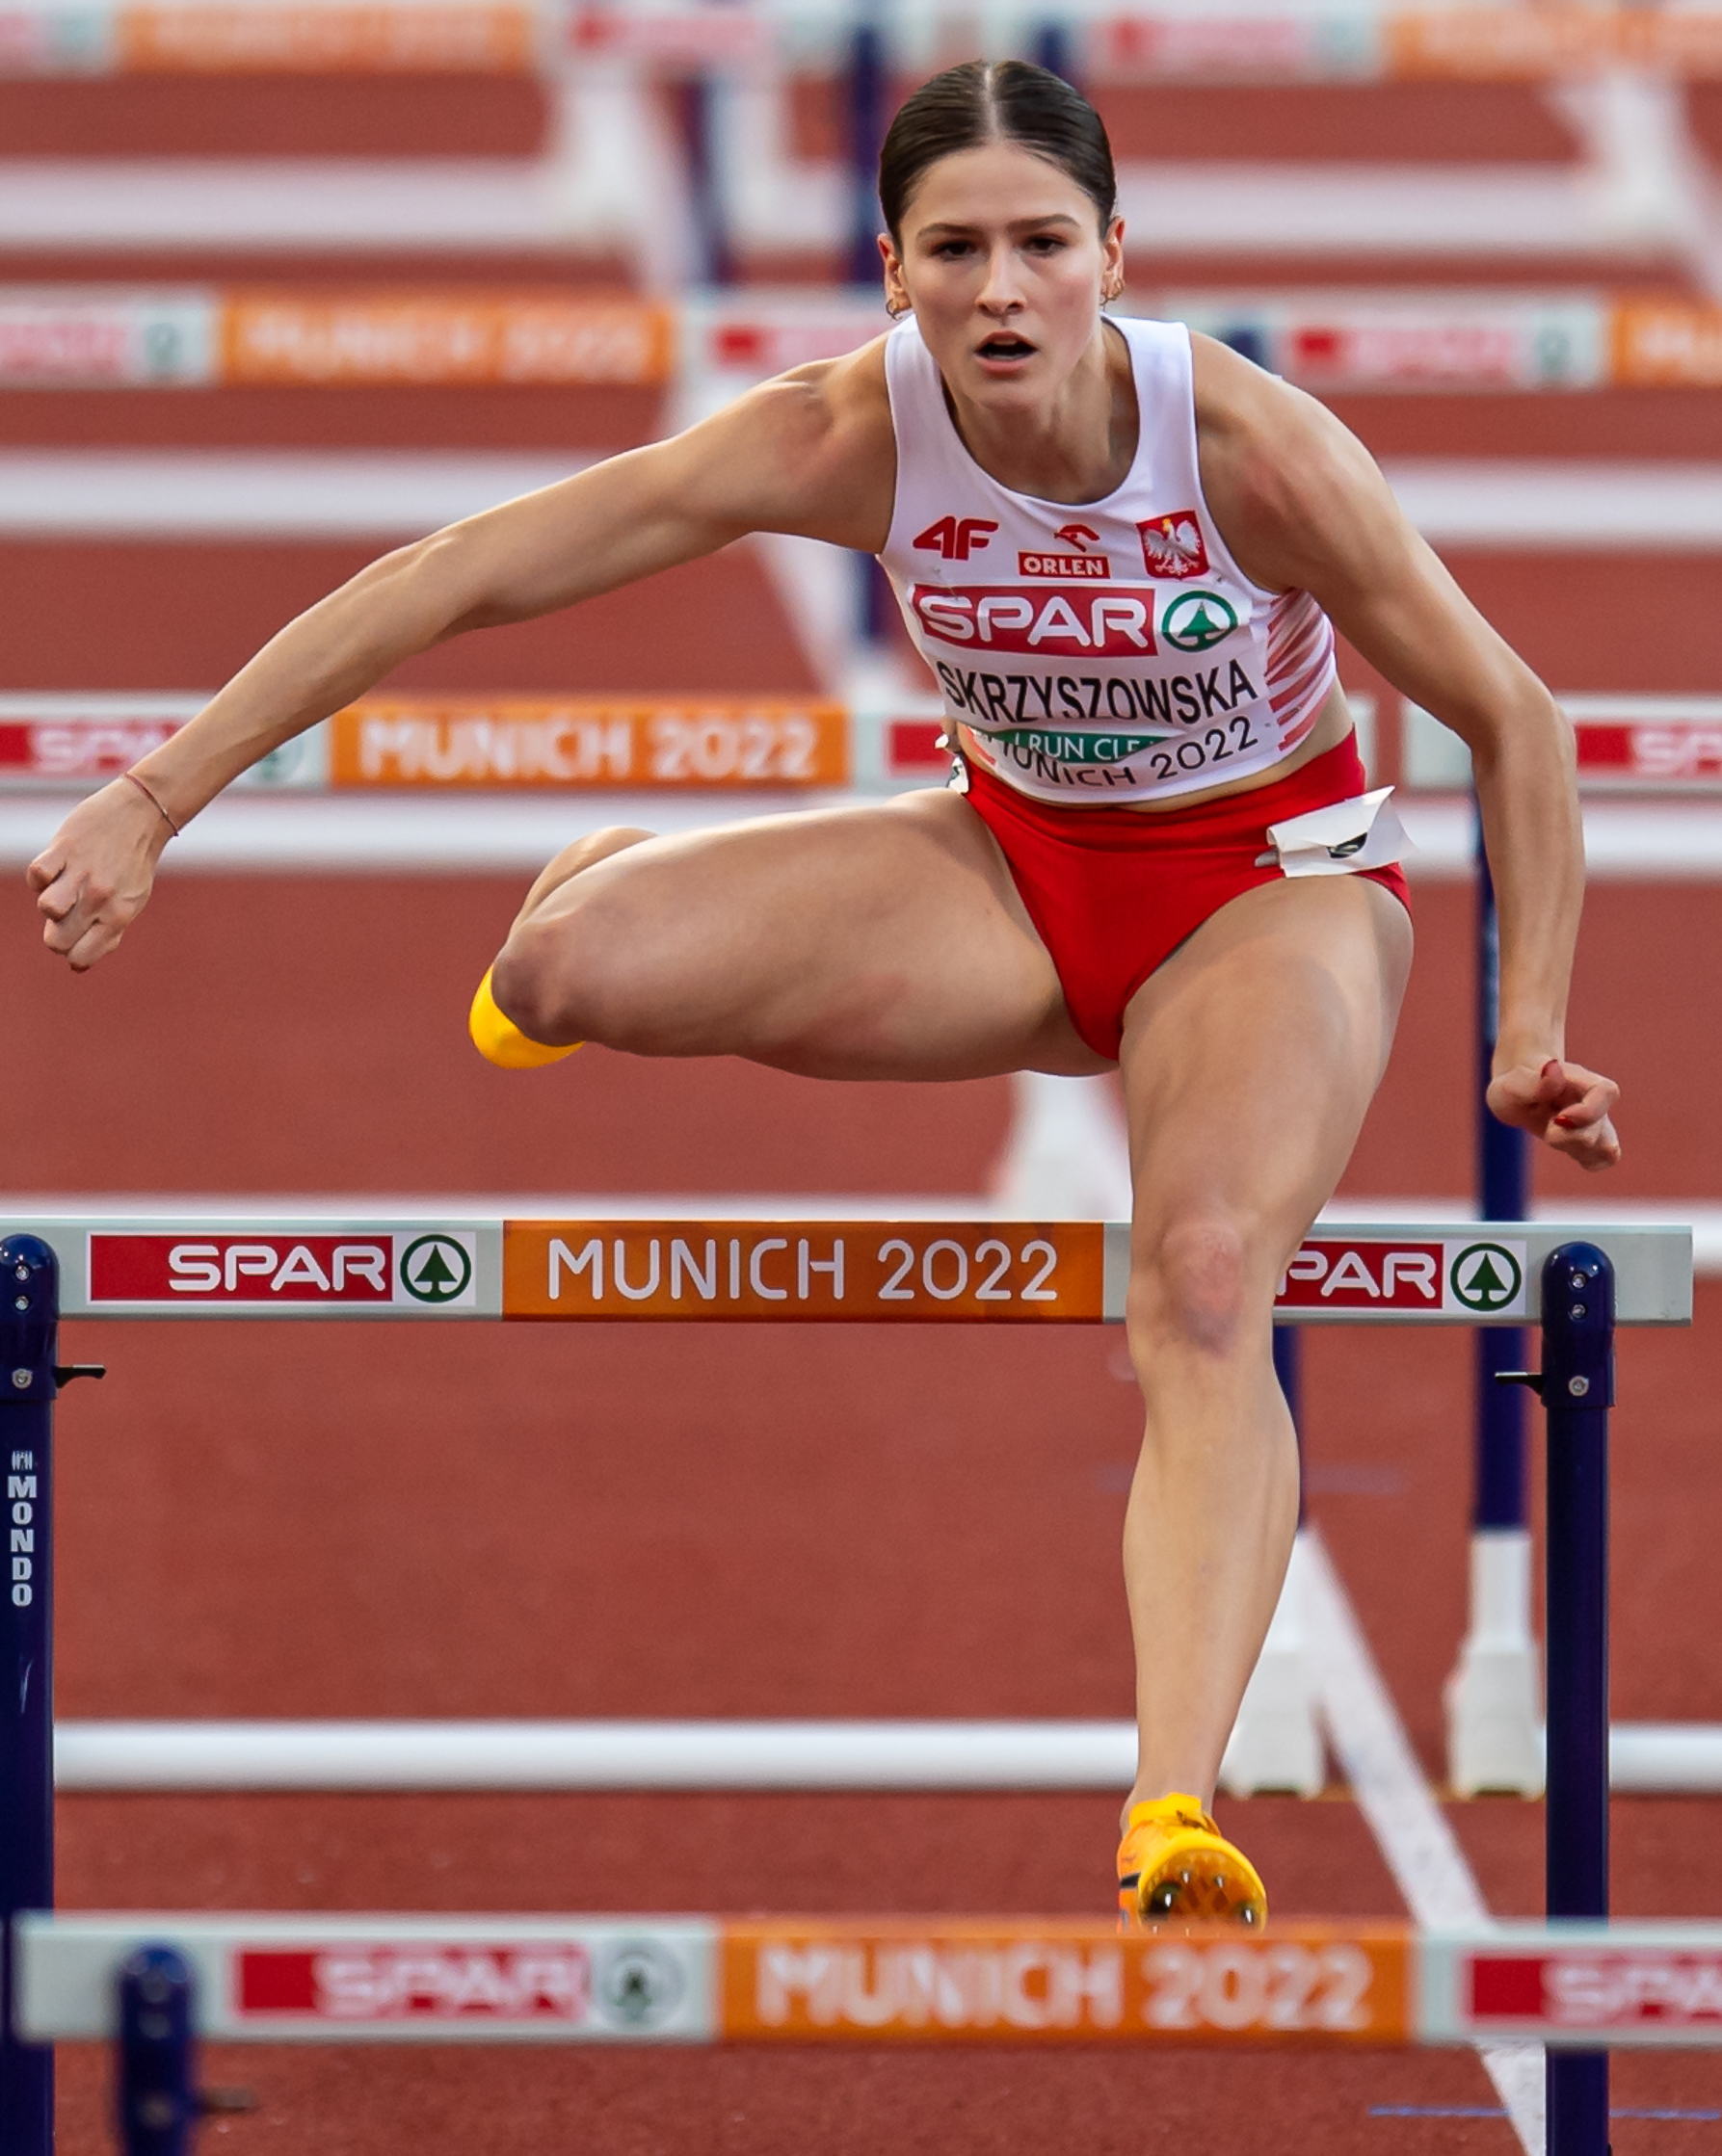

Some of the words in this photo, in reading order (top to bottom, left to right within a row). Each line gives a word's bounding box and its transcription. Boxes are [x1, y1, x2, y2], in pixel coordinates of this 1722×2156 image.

[913, 515, 998, 561] 4F
[1022, 556, 1104, 576] ORLEN
[918, 594, 1149, 648] SPAR
[936, 658, 1259, 724] SKRZYSZOWSKA
[361, 720, 631, 779] MUNICH
[653, 720, 816, 779] 2022
[987, 734, 1137, 786] UNICH
[1150, 715, 1258, 780] 2022
[1028, 733, 1085, 759] RUN
[1094, 737, 1155, 761] CLE
[168, 1245, 386, 1292] SPAR
[547, 1239, 845, 1301] MUNICH
[878, 1239, 1058, 1301] 2022
[8, 1475, 37, 1607] MONDO
[318, 1950, 574, 2019] SPAR
[757, 1942, 1125, 2028] MUNICH
[1142, 1941, 1373, 2031] 2022
